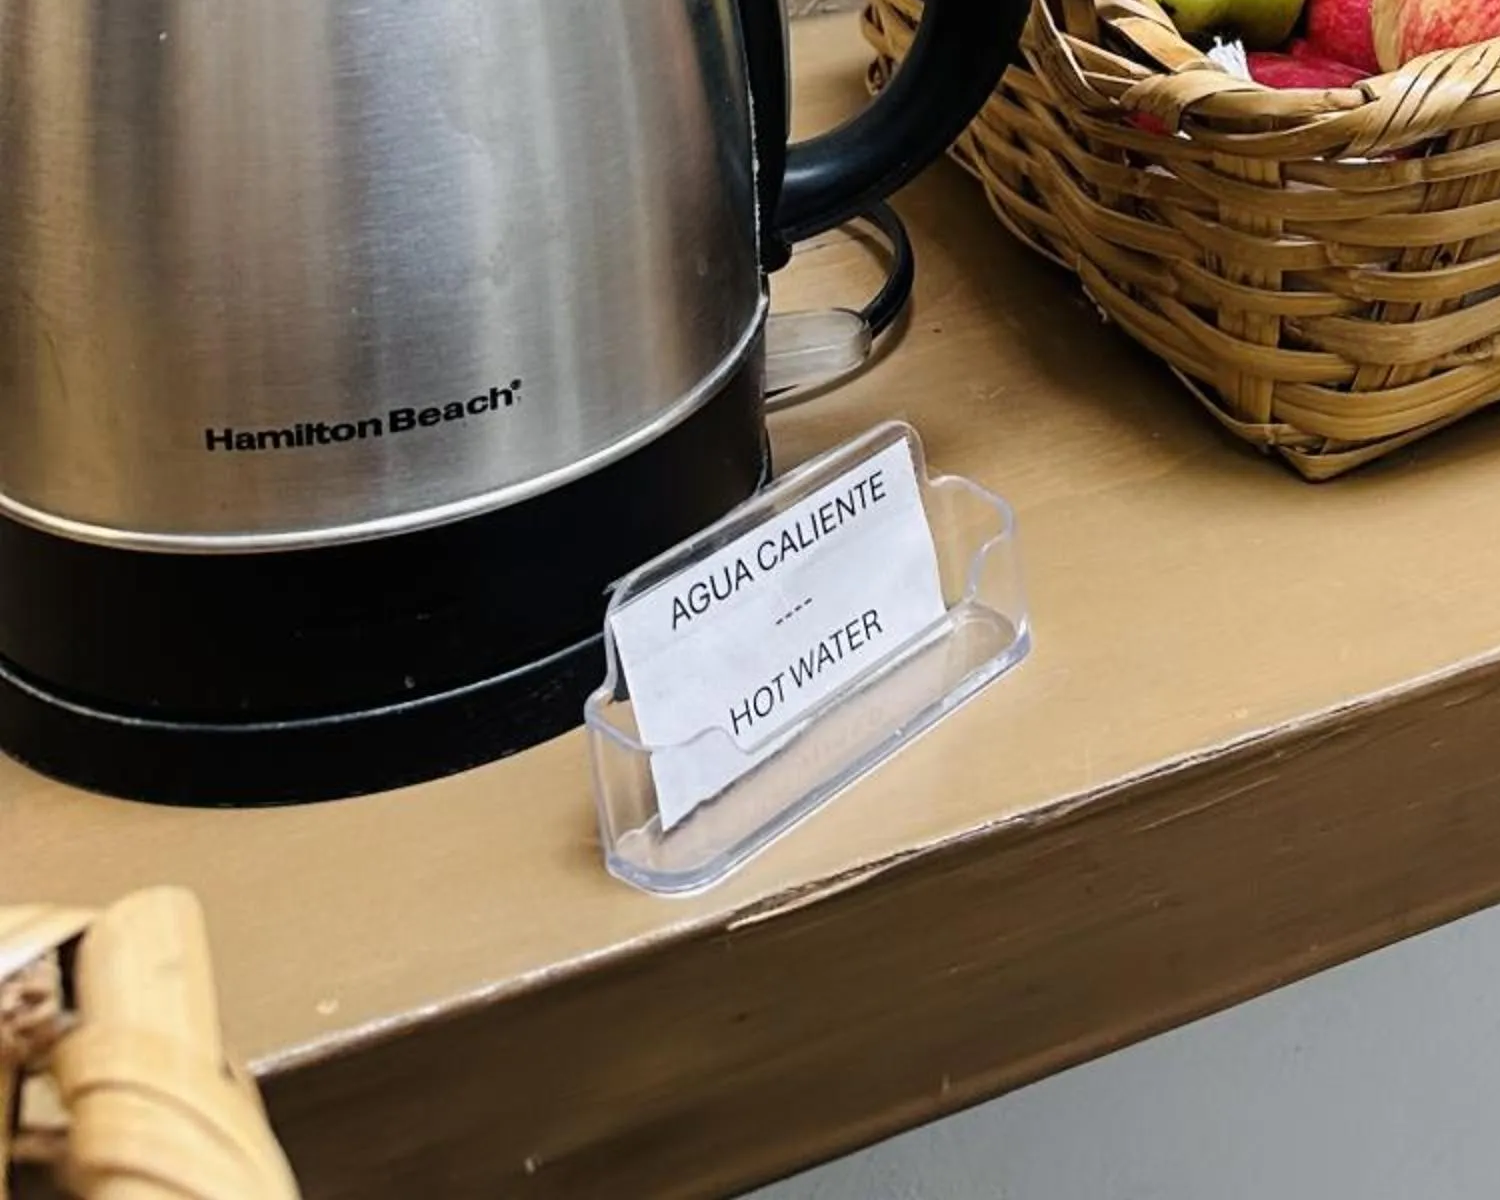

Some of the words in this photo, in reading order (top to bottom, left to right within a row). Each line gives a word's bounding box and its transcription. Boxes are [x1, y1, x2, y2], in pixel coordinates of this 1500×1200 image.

[205, 415, 384, 452] Hamilton
[671, 557, 755, 630] AGUA
[756, 470, 887, 572] CALIENTE
[729, 672, 787, 736] HOT
[788, 608, 884, 690] WATER
